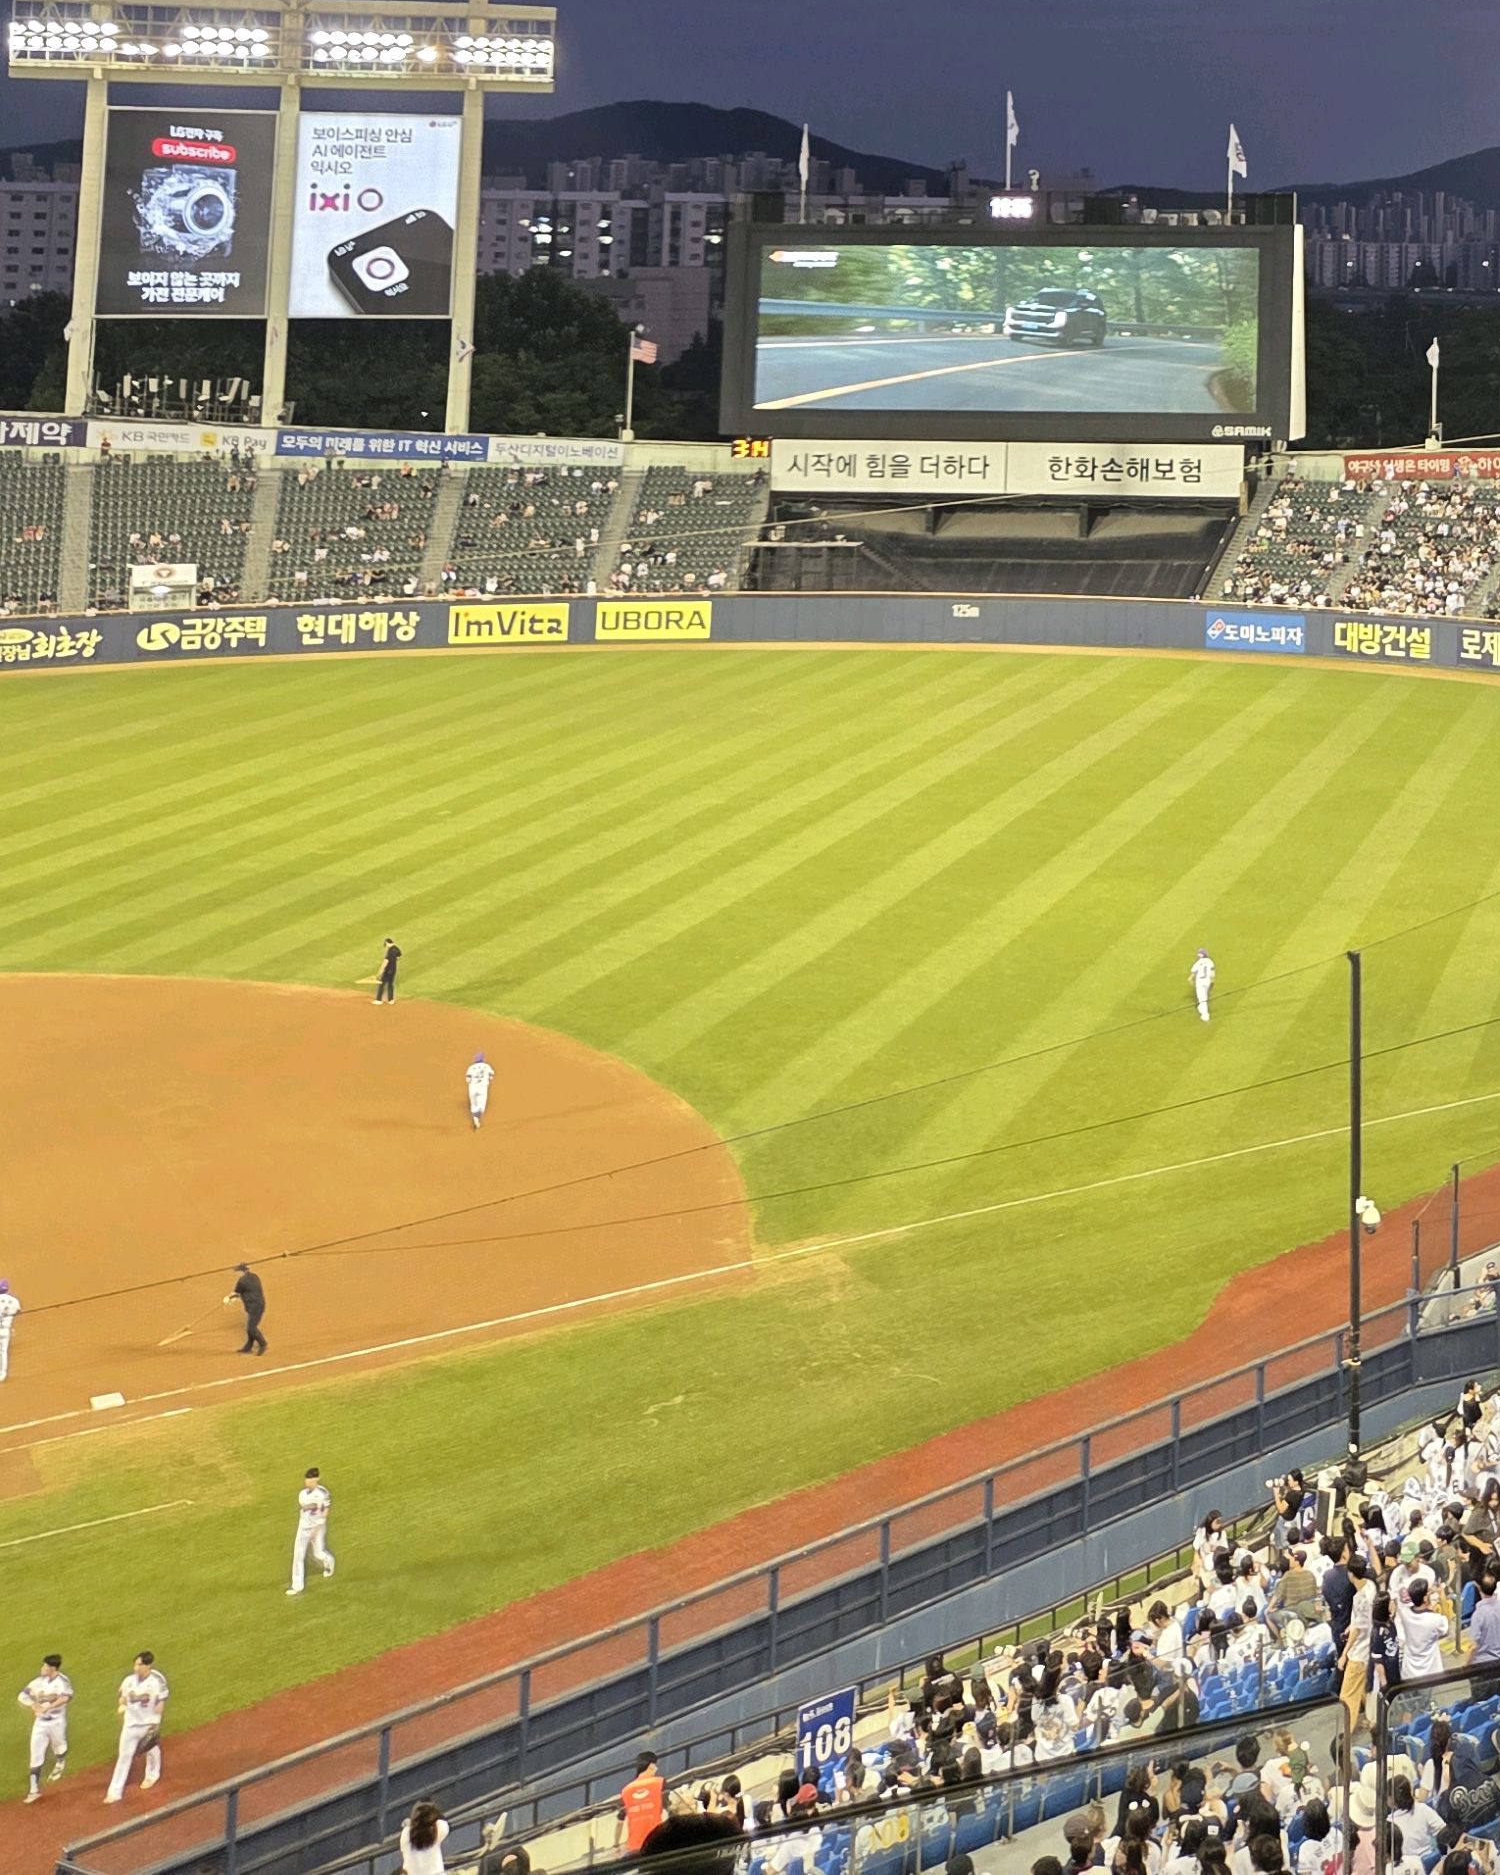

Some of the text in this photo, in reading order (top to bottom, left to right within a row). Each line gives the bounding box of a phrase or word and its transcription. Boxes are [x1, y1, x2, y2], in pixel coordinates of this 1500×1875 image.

[312, 127, 412, 143] 보이스피싱 안심
[162, 143, 230, 159] subscribe
[312, 144, 387, 159] AI 에이전트
[310, 161, 353, 175] 익시오
[122, 431, 144, 442] KB
[222, 435, 267, 449] KB Pay
[1224, 426, 1272, 437] SAMIK
[281, 435, 322, 451] 모두의
[368, 438, 396, 453] 위한
[398, 439, 413, 453] IT
[415, 439, 441, 454] 혁신
[444, 440, 484, 456] 서비스
[495, 443, 619, 460] 두산디지털이노베이션
[788, 453, 991, 480] 시작에 힘을 더하다
[1048, 456, 1202, 483] 한화손해보험
[1418, 458, 1450, 473] 타이밍
[296, 611, 420, 645] 현대해상
[453, 611, 563, 638] I'mVita
[601, 610, 707, 631] UBORA
[32, 626, 103, 658] 회초장
[181, 616, 268, 650] 금강주택
[1223, 624, 1304, 646] 도미노피자
[1334, 622, 1431, 659] 대방건설
[800, 1716, 851, 1768] 108
